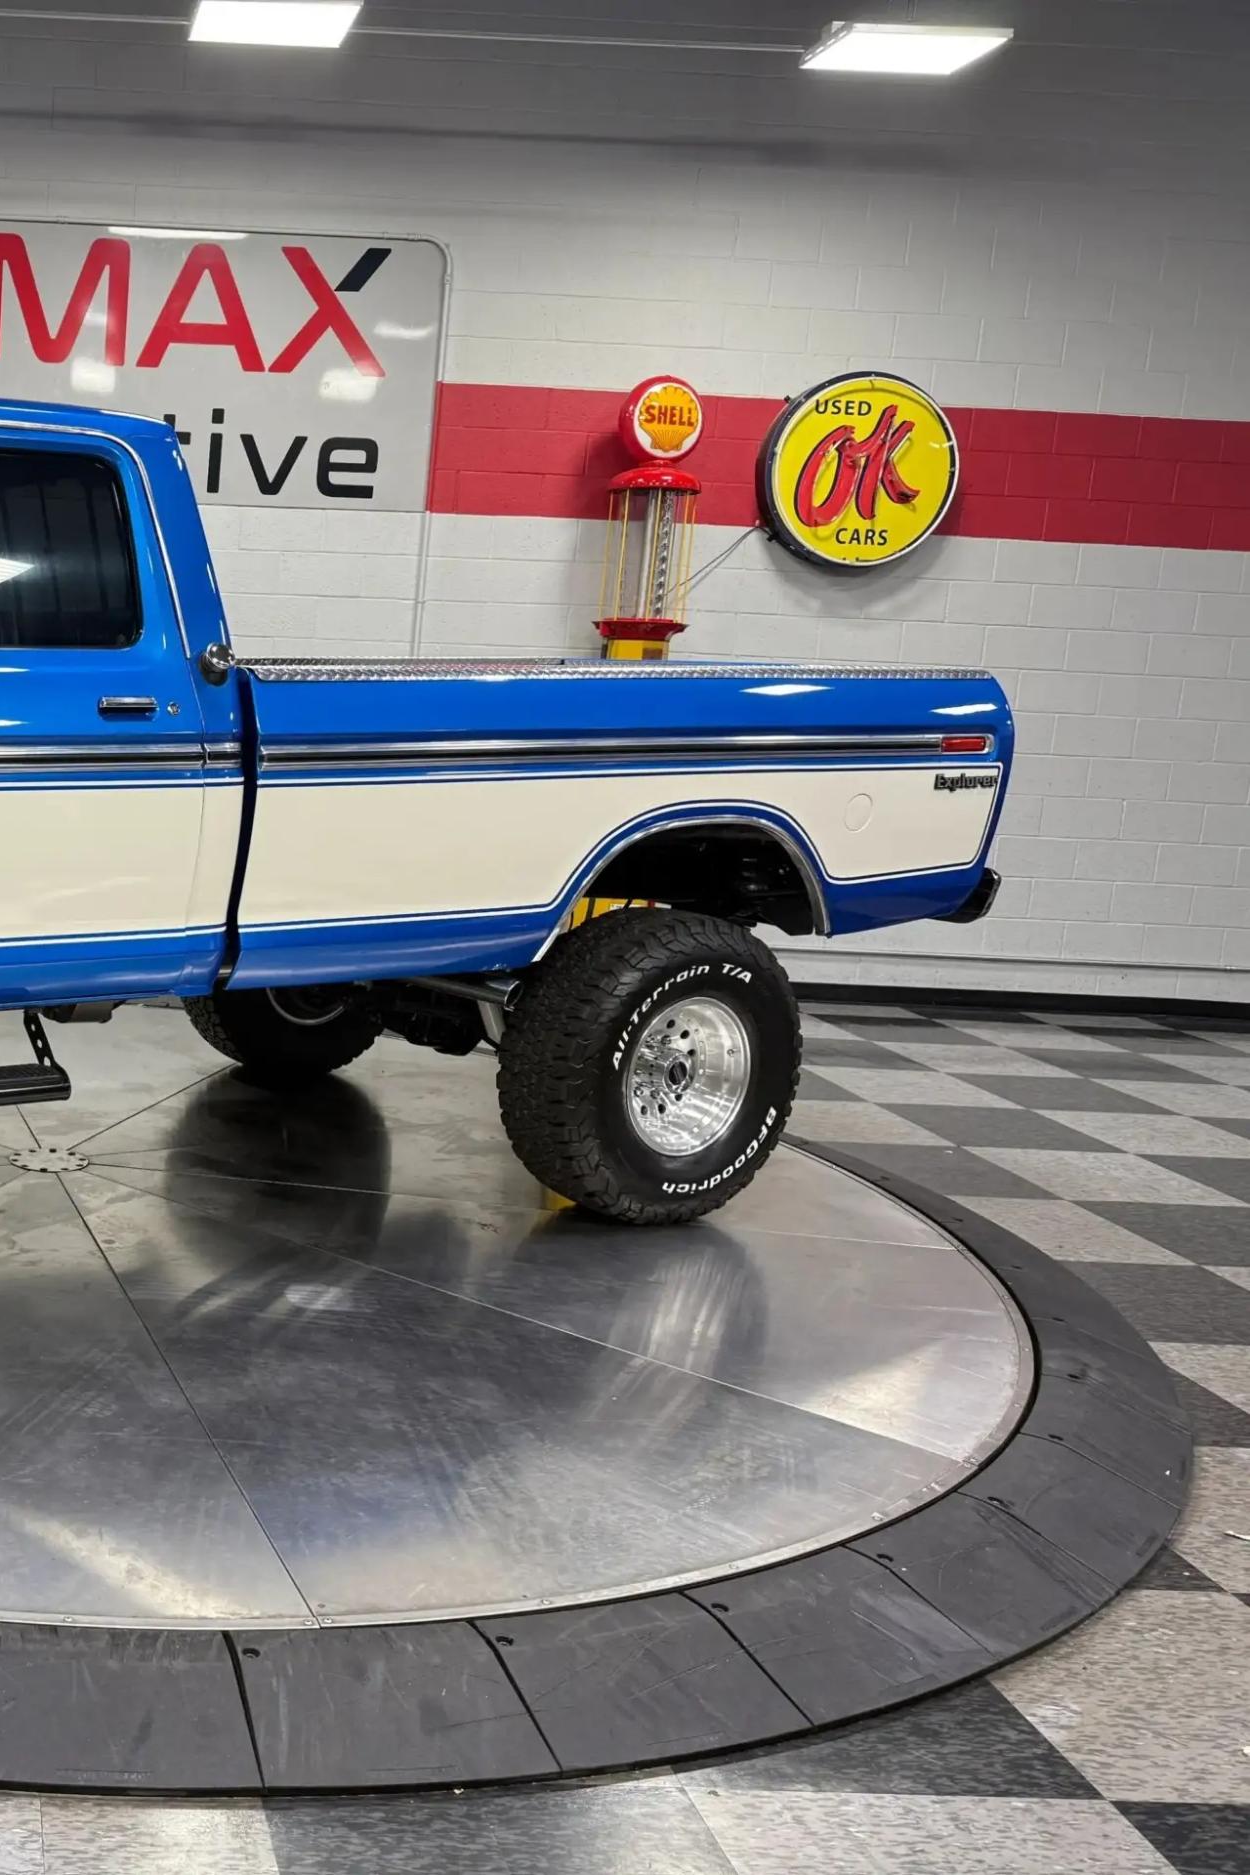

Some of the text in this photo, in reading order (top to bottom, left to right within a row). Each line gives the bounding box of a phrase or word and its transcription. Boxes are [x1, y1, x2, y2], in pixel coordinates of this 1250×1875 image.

[643, 403, 695, 427] SHELL
[814, 399, 872, 416] USED
[793, 404, 921, 528] OK
[835, 527, 888, 546] CARS
[934, 773, 999, 793] Explorer
[612, 962, 753, 1071] All-Terrain T/A
[662, 1106, 778, 1195] BFGoodrich
